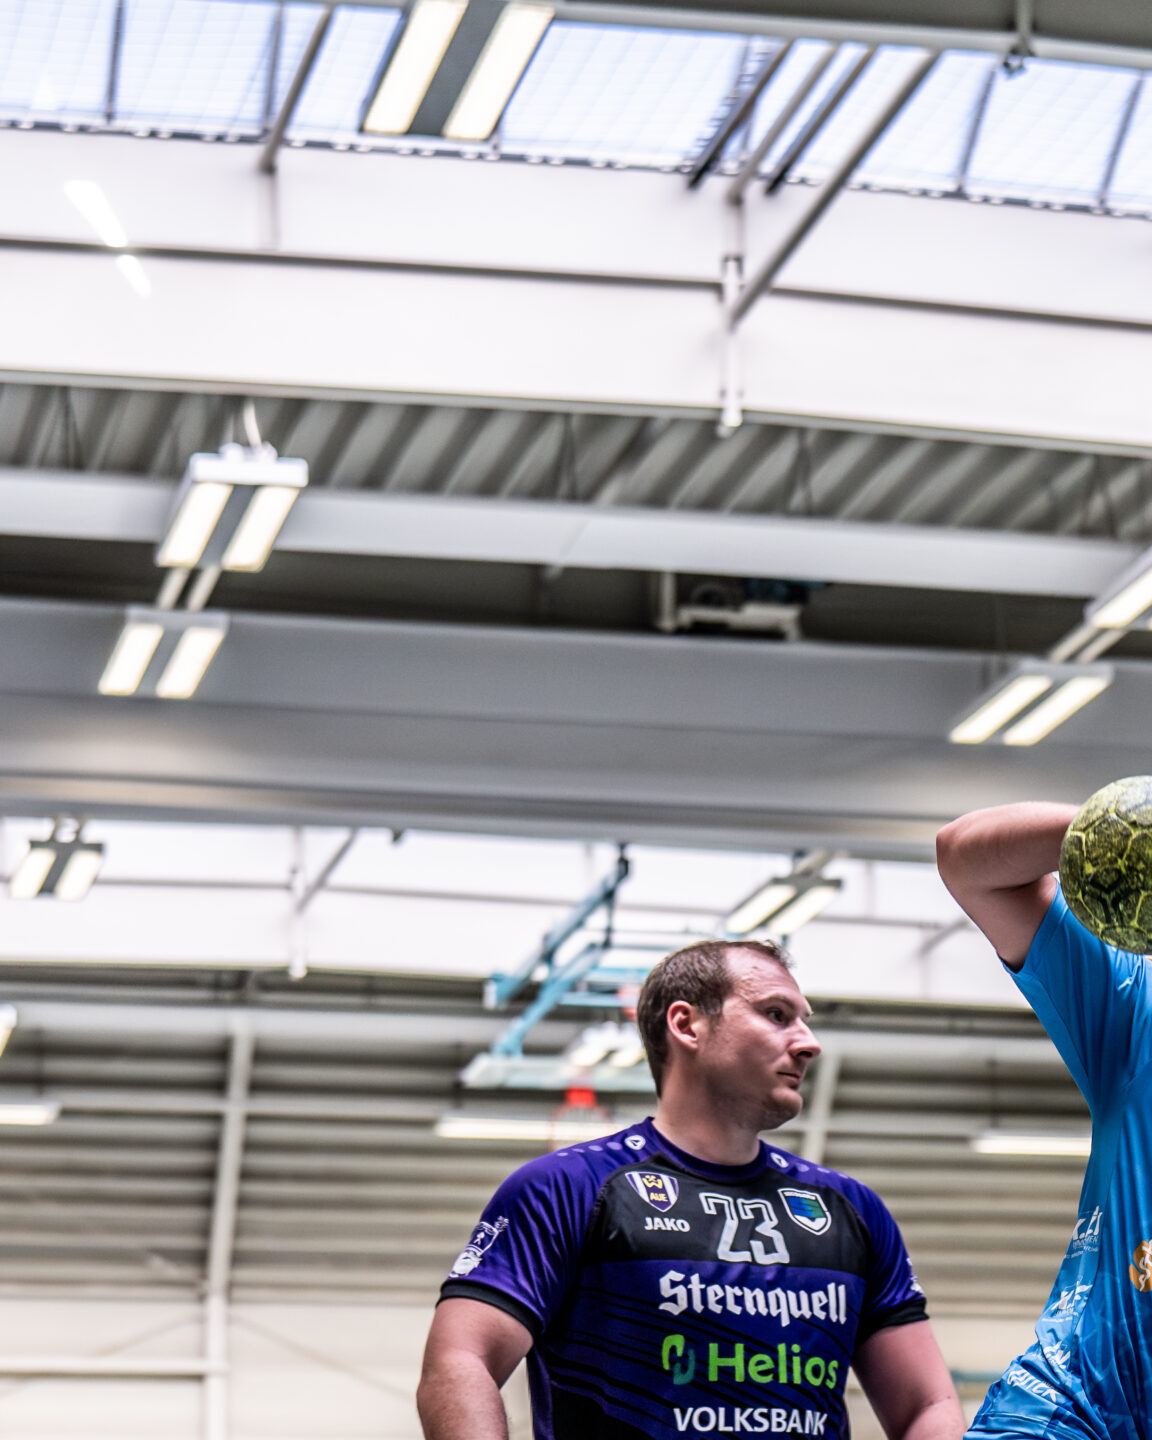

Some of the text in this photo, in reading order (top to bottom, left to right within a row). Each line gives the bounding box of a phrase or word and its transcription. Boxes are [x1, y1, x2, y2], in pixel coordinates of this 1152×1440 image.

[644, 1216, 691, 1233] JAKO
[699, 1192, 790, 1265] 23
[658, 1270, 847, 1328] Sternquell
[708, 1342, 839, 1390] Helios
[673, 1406, 828, 1436] VOLKSBANK
